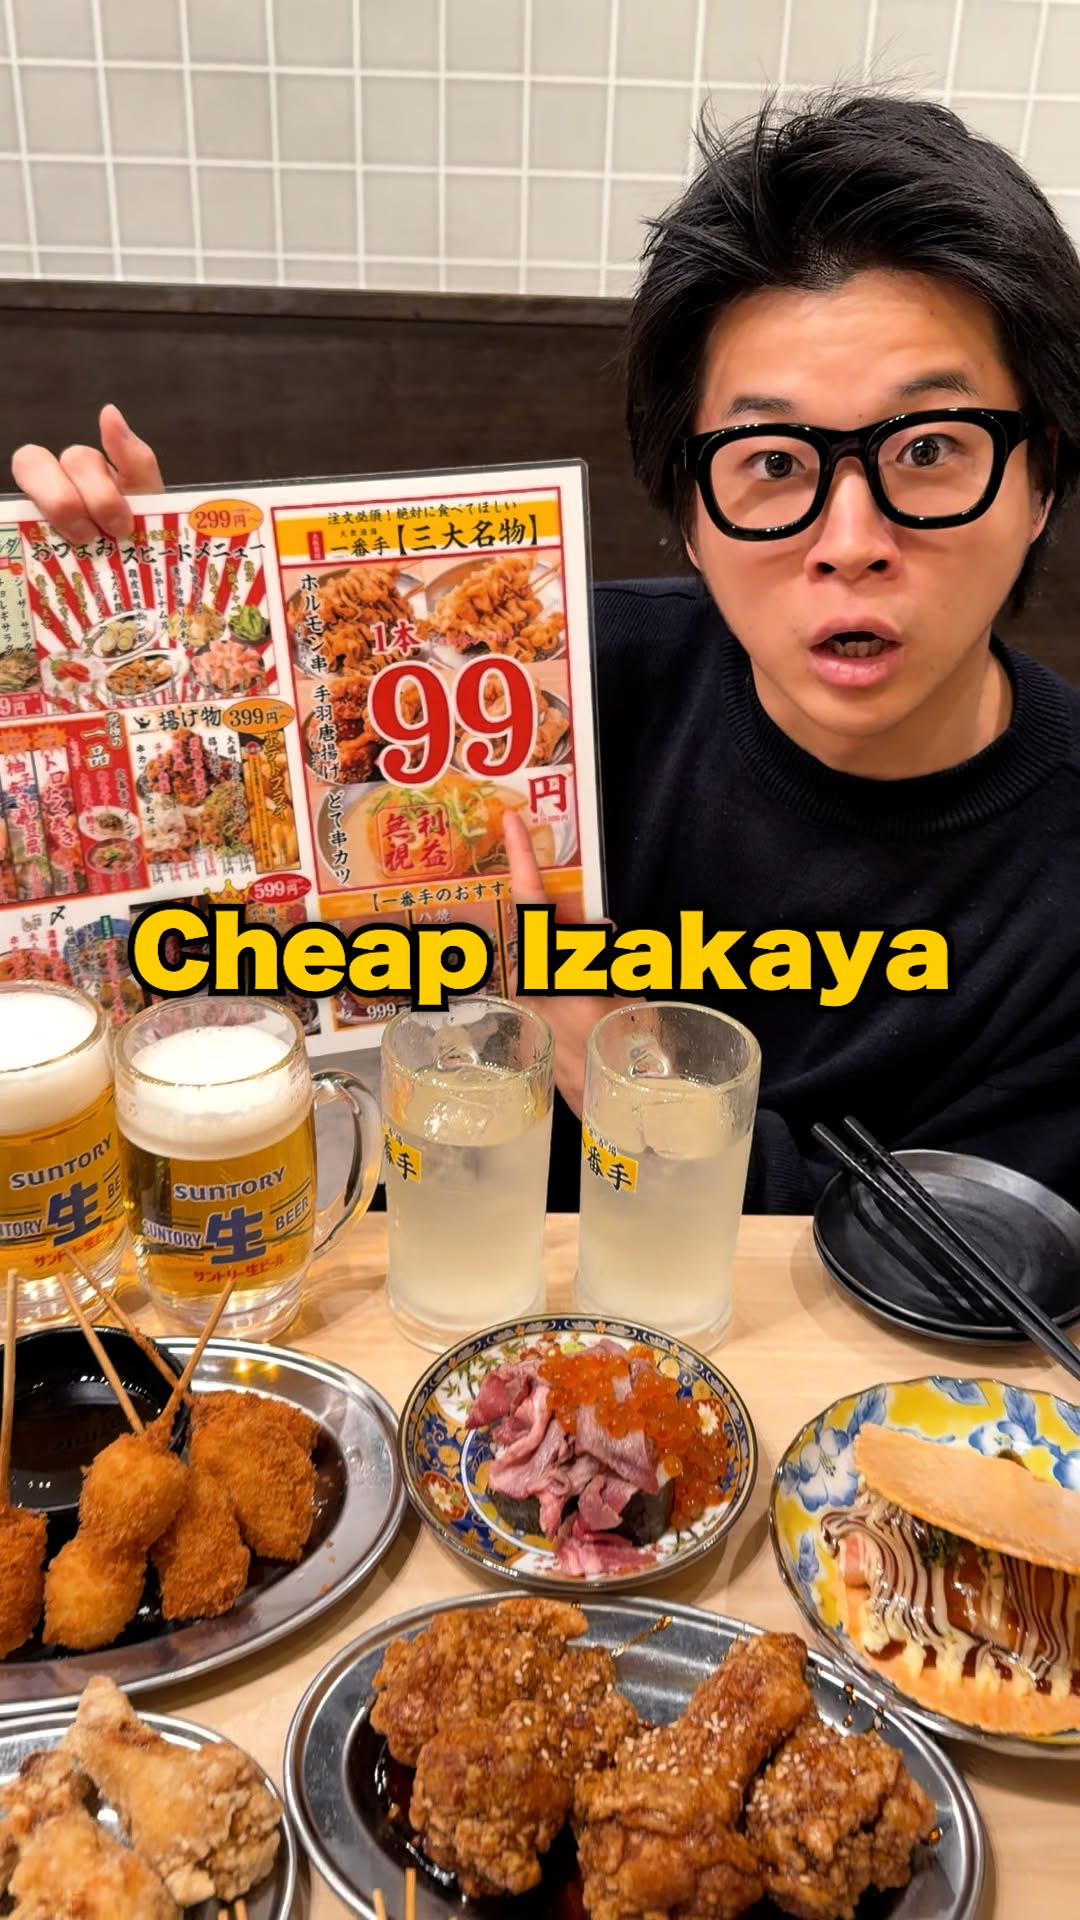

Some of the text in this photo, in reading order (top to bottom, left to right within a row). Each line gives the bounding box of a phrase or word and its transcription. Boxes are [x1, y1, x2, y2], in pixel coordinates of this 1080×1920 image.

[300, 573, 328, 673] ホルモン串
[370, 621, 421, 658] 1本
[159, 706, 222, 731] 揚げ物
[313, 684, 339, 781] 手羽唐揚げ
[371, 657, 535, 787] 99
[527, 773, 568, 814] 円
[326, 790, 351, 886] どて串カツ
[372, 881, 512, 912] 【一番手のおすす
[366, 1002, 397, 1019] 999
[10, 1133, 112, 1188] SUNTORY
[174, 1166, 285, 1201] SUNTORY
[47, 1181, 103, 1247] 生
[142, 1196, 309, 1264] SUNTORY 生 BEER
